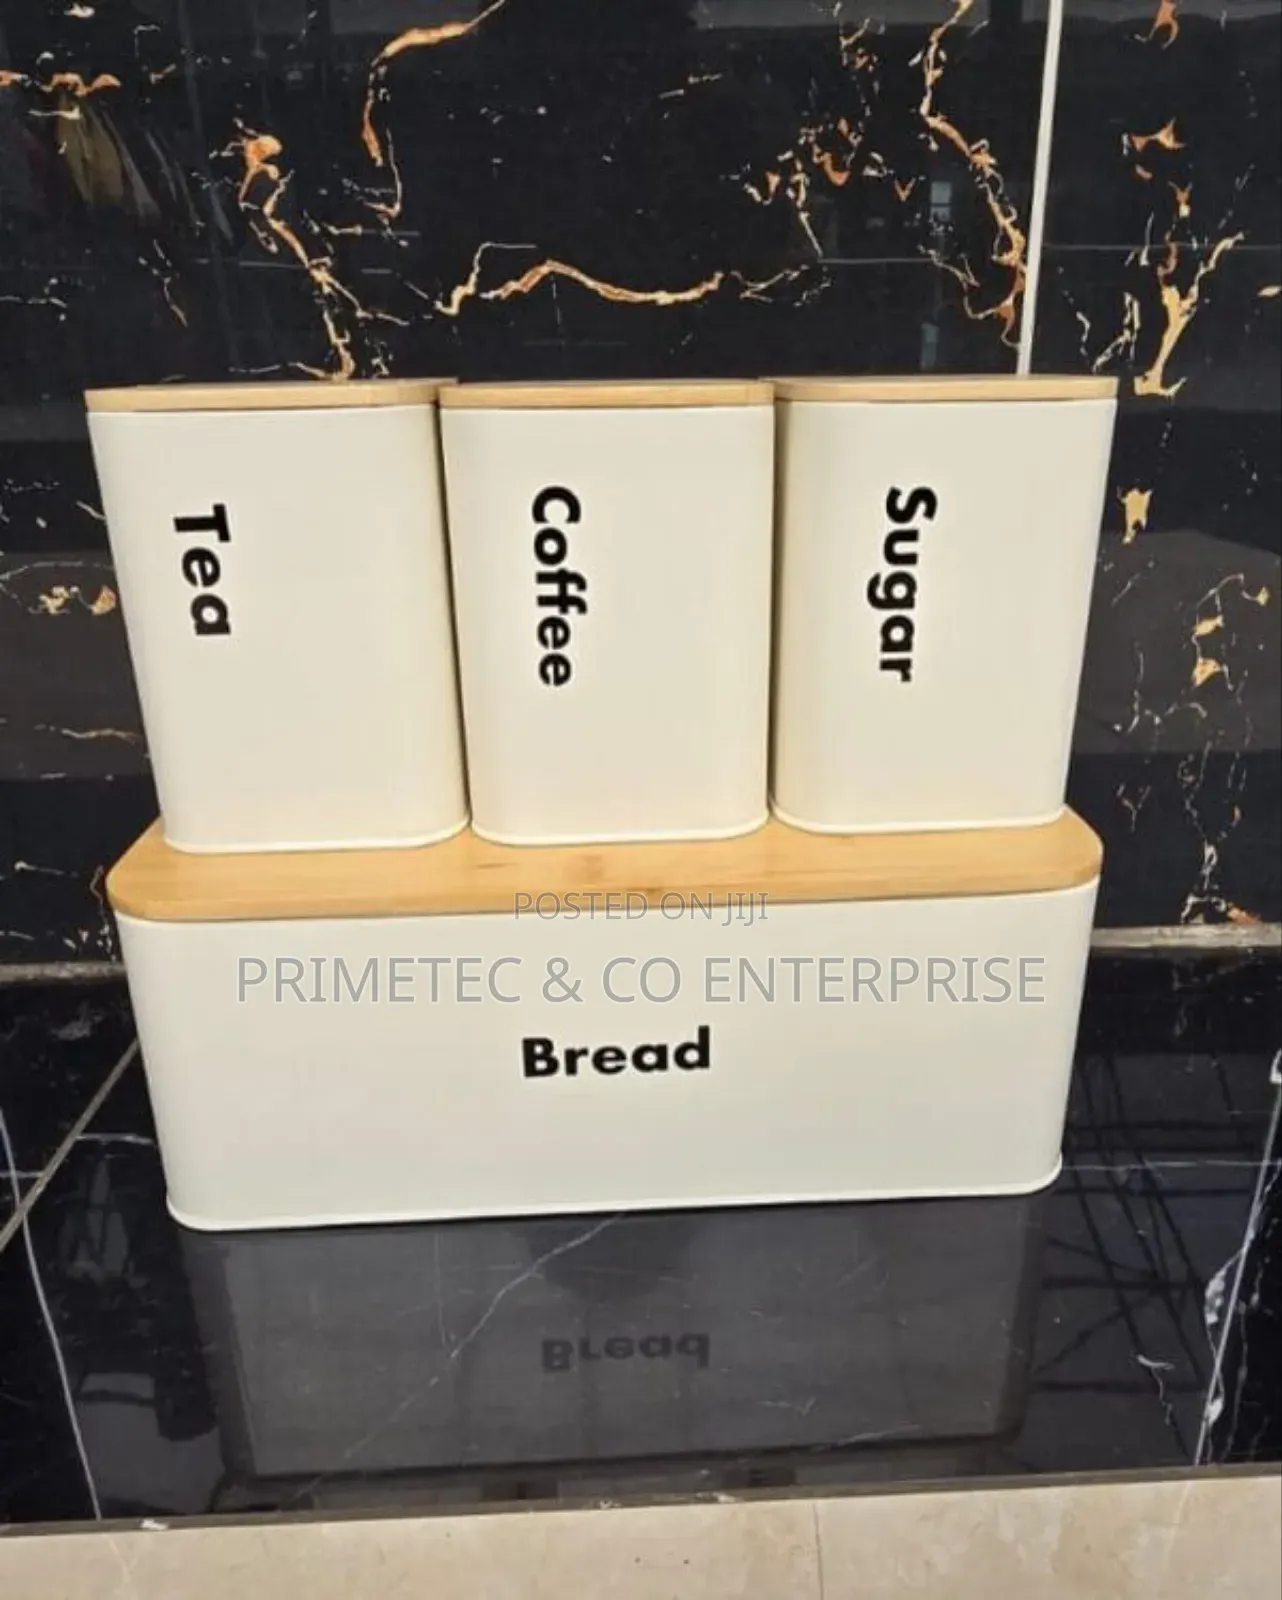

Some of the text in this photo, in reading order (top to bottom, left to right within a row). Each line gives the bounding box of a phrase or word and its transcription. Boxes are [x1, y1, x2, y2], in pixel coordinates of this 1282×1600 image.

[173, 502, 232, 636] Tea
[531, 486, 588, 688] Coffee
[867, 486, 938, 683] Sugar
[522, 1025, 711, 1079] Bread
